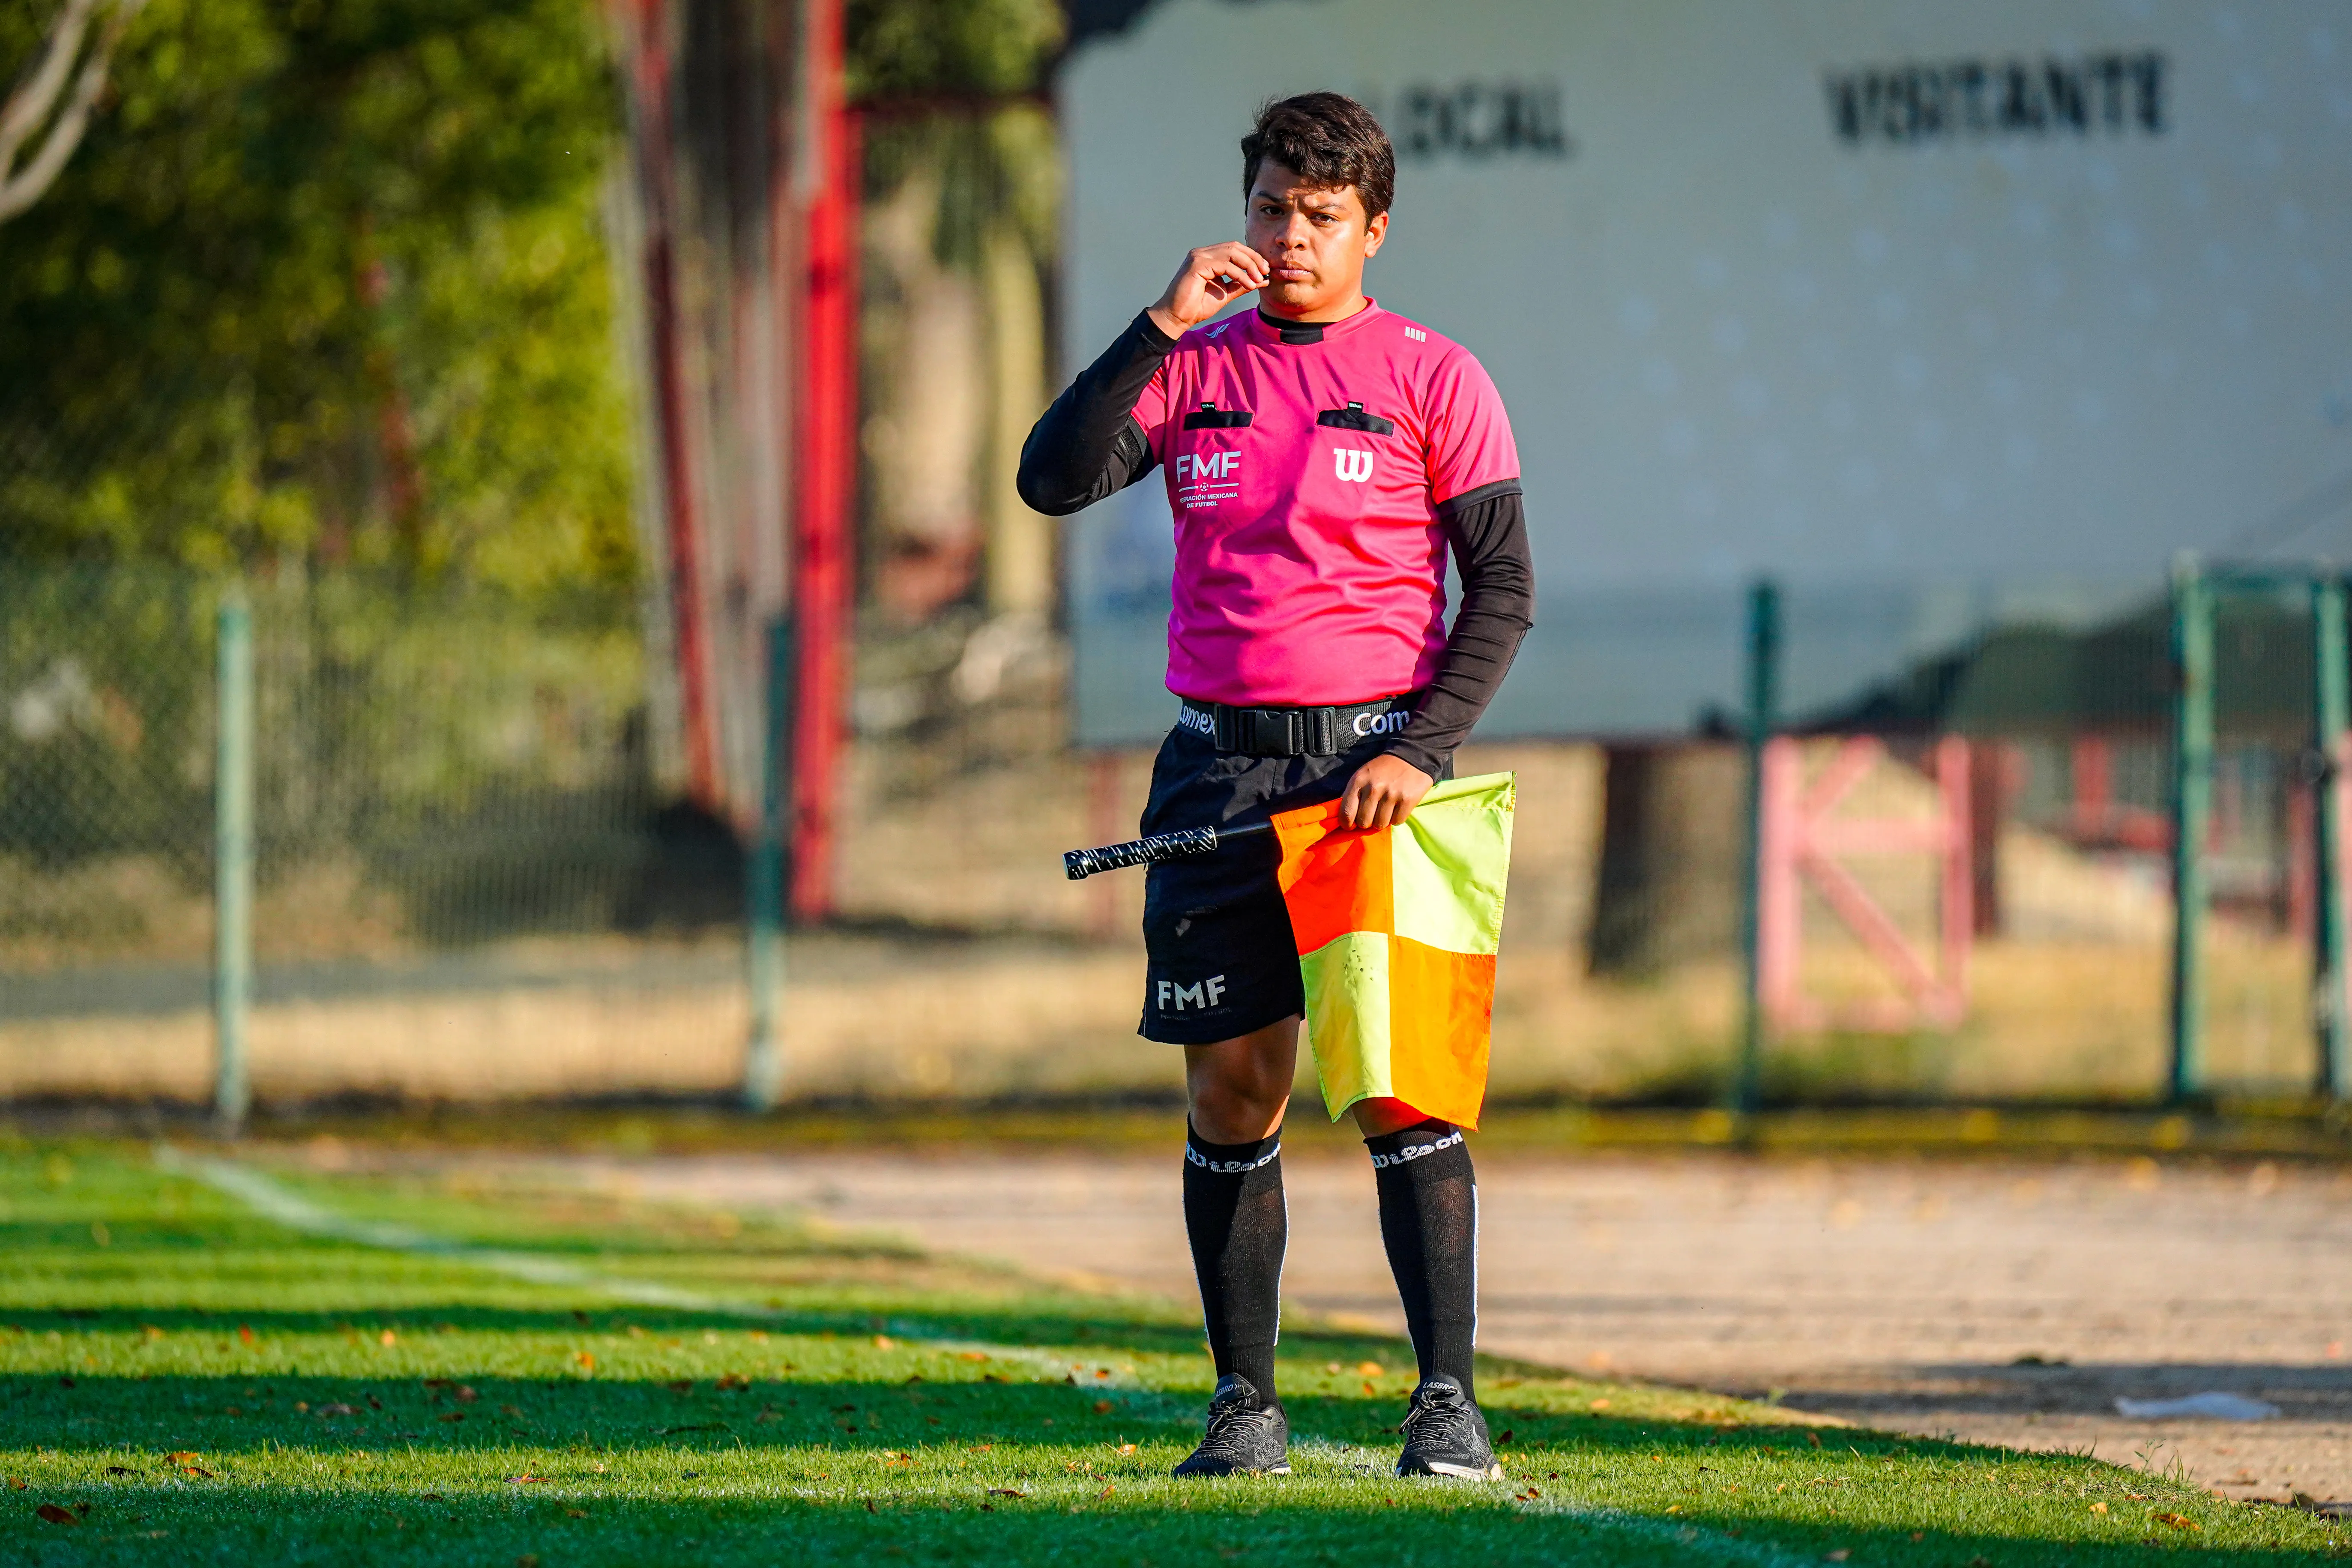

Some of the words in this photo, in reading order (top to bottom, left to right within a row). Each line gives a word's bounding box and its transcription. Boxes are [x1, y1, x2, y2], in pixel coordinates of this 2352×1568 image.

[1823, 51, 2169, 148] VISITANTE
[1176, 451, 1241, 483] FMF
[1158, 975, 1226, 1010] FMF
[1214, 1384, 1234, 1400] ASBRO
